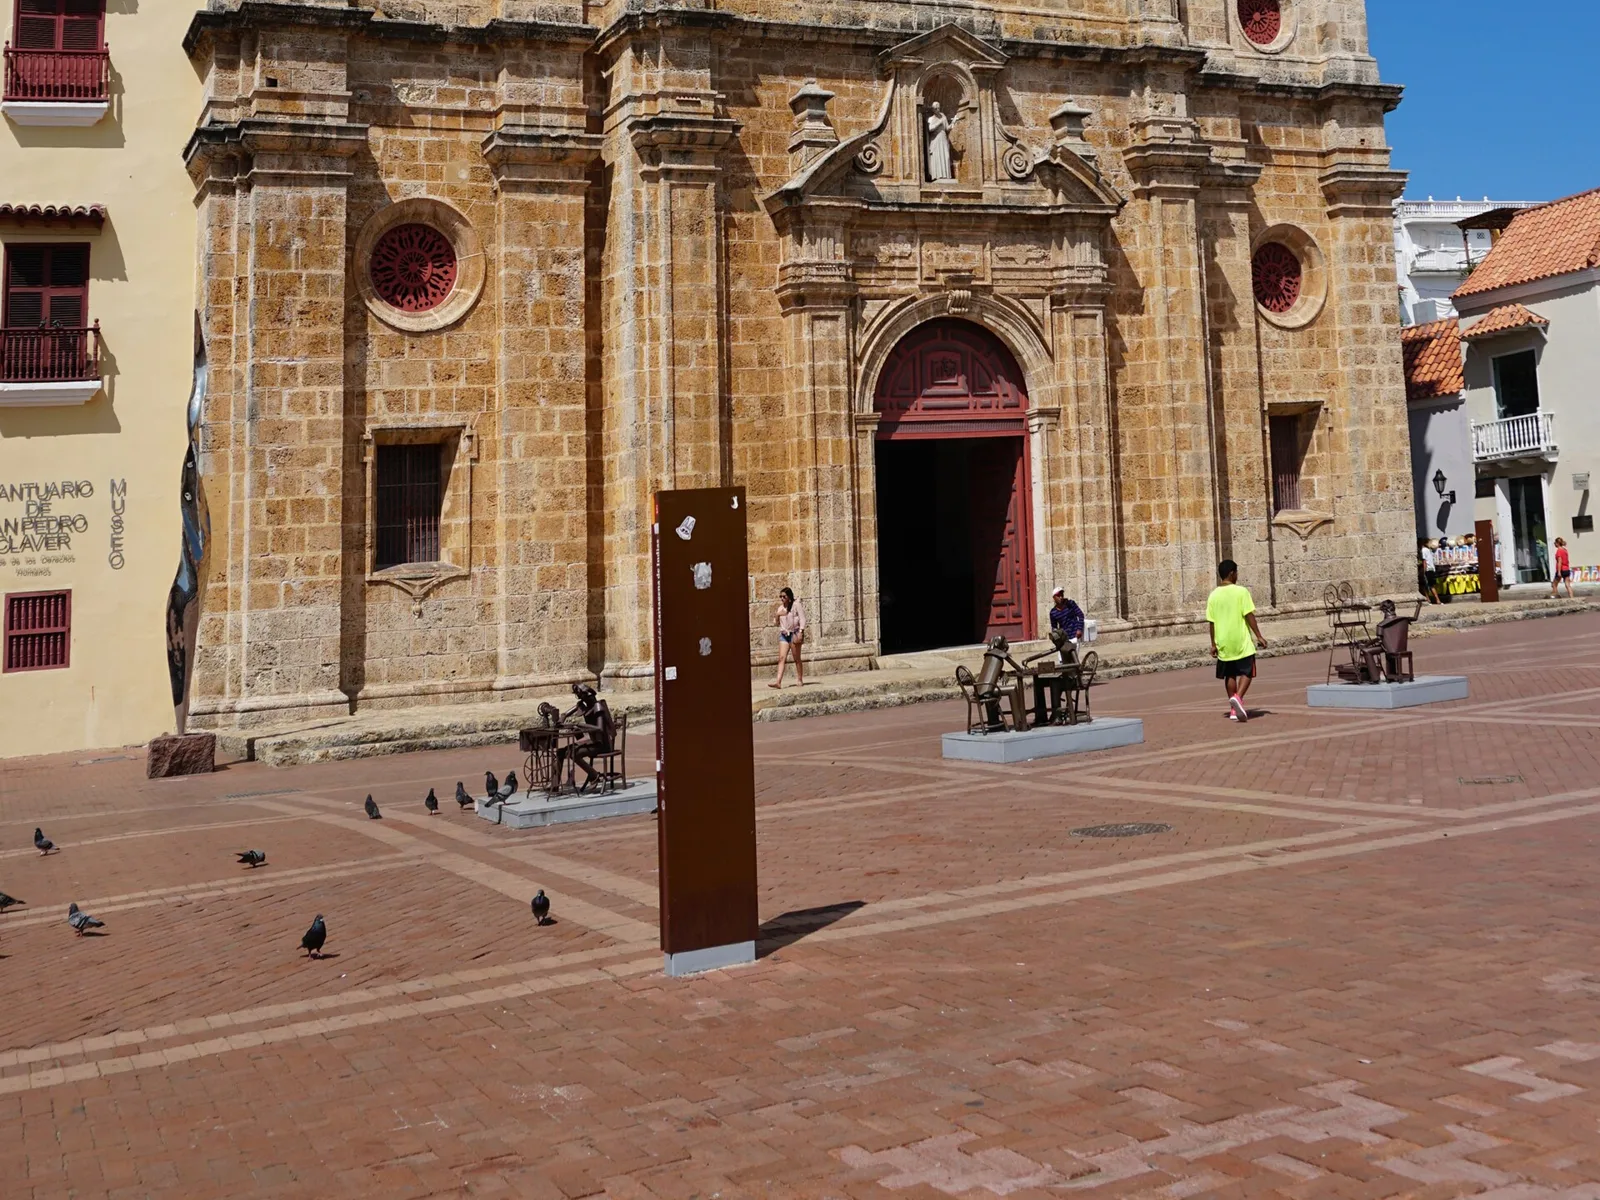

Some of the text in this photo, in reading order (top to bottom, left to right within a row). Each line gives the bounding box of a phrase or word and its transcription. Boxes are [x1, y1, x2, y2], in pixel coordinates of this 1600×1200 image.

[26, 500, 52, 518] DE
[21, 514, 88, 534] PEDRO
[108, 478, 126, 570] MUSEO
